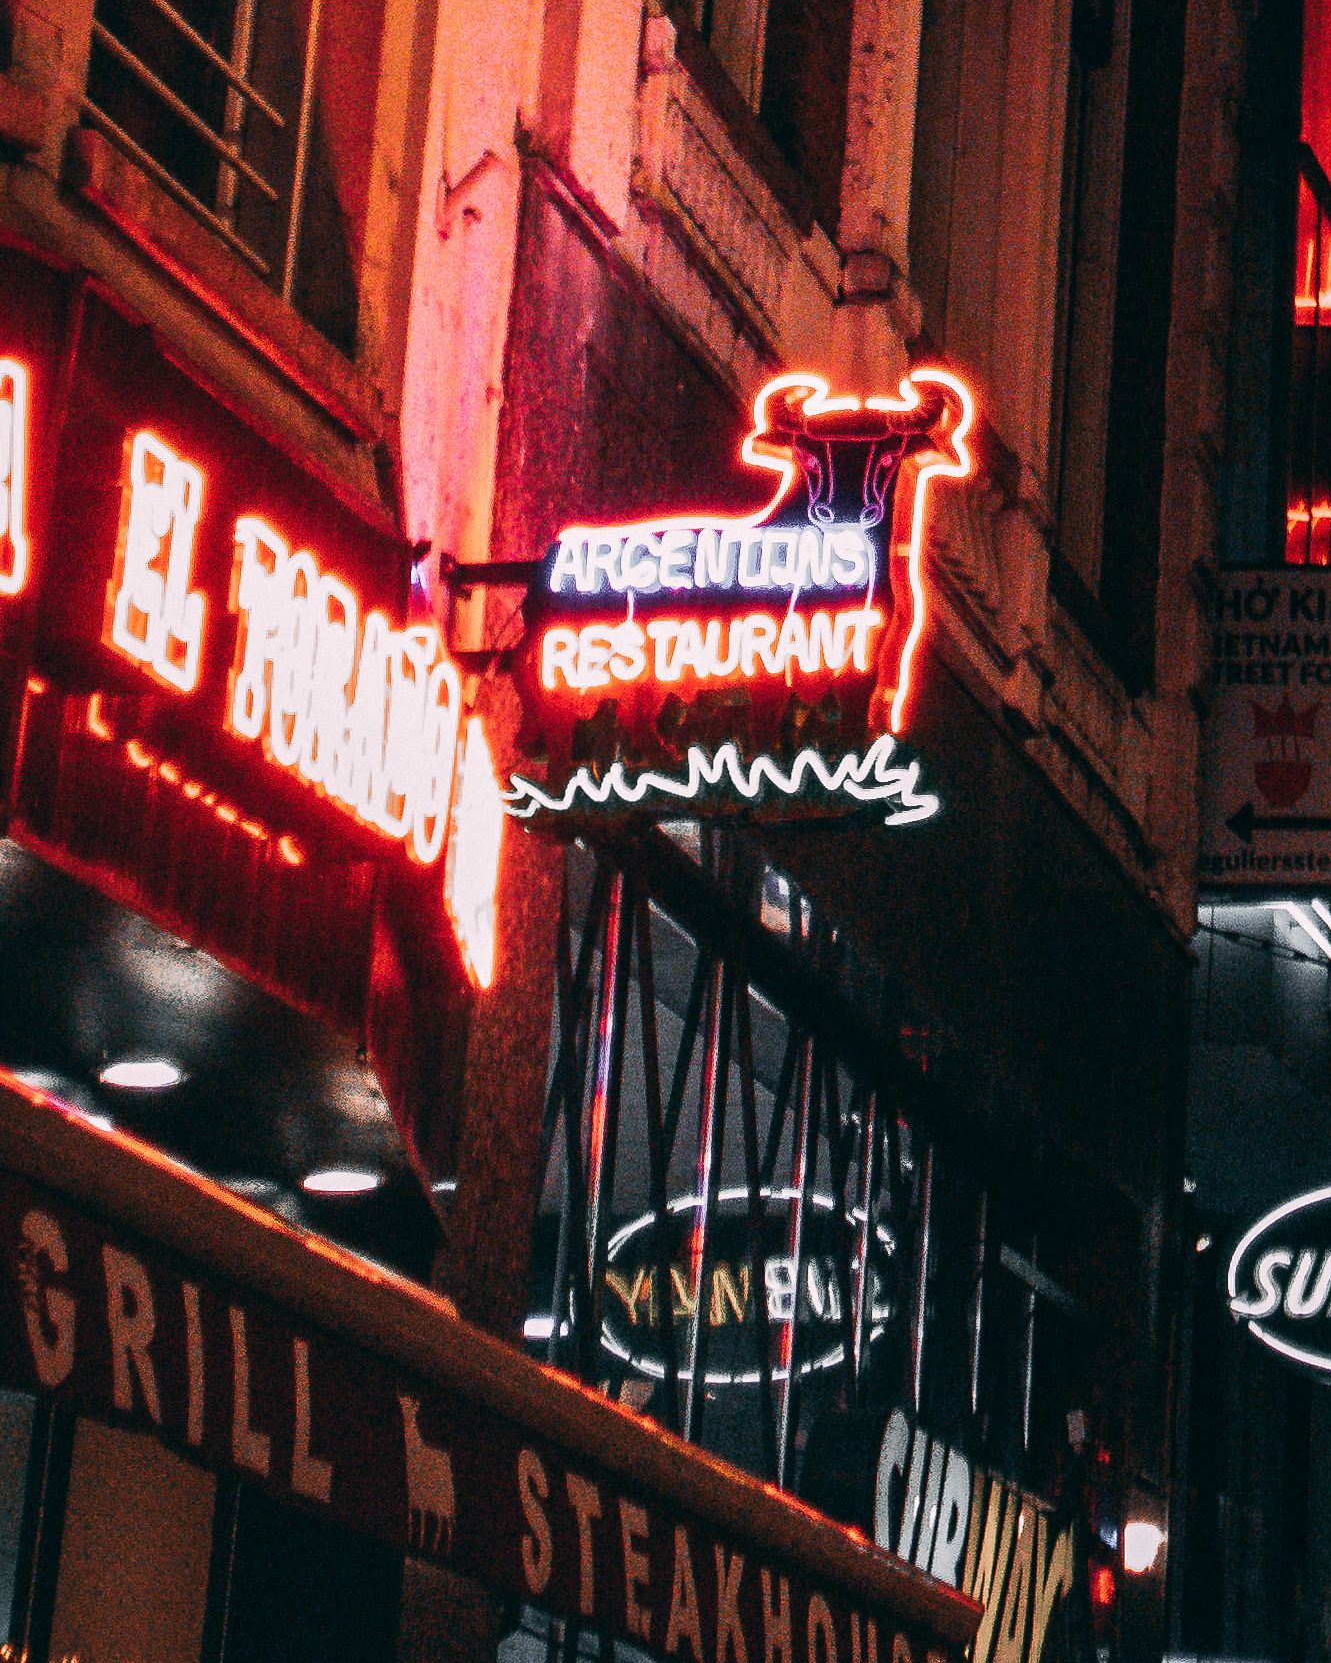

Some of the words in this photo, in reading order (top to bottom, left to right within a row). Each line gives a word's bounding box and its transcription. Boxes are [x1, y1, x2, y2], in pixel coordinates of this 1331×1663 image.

[1215, 576, 1280, 623] HỞ
[542, 609, 881, 691] RESTAURANT
[1212, 660, 1294, 686] TREET
[16, 1208, 335, 1506] GRILL
[516, 1447, 950, 1663] STEAKHO
